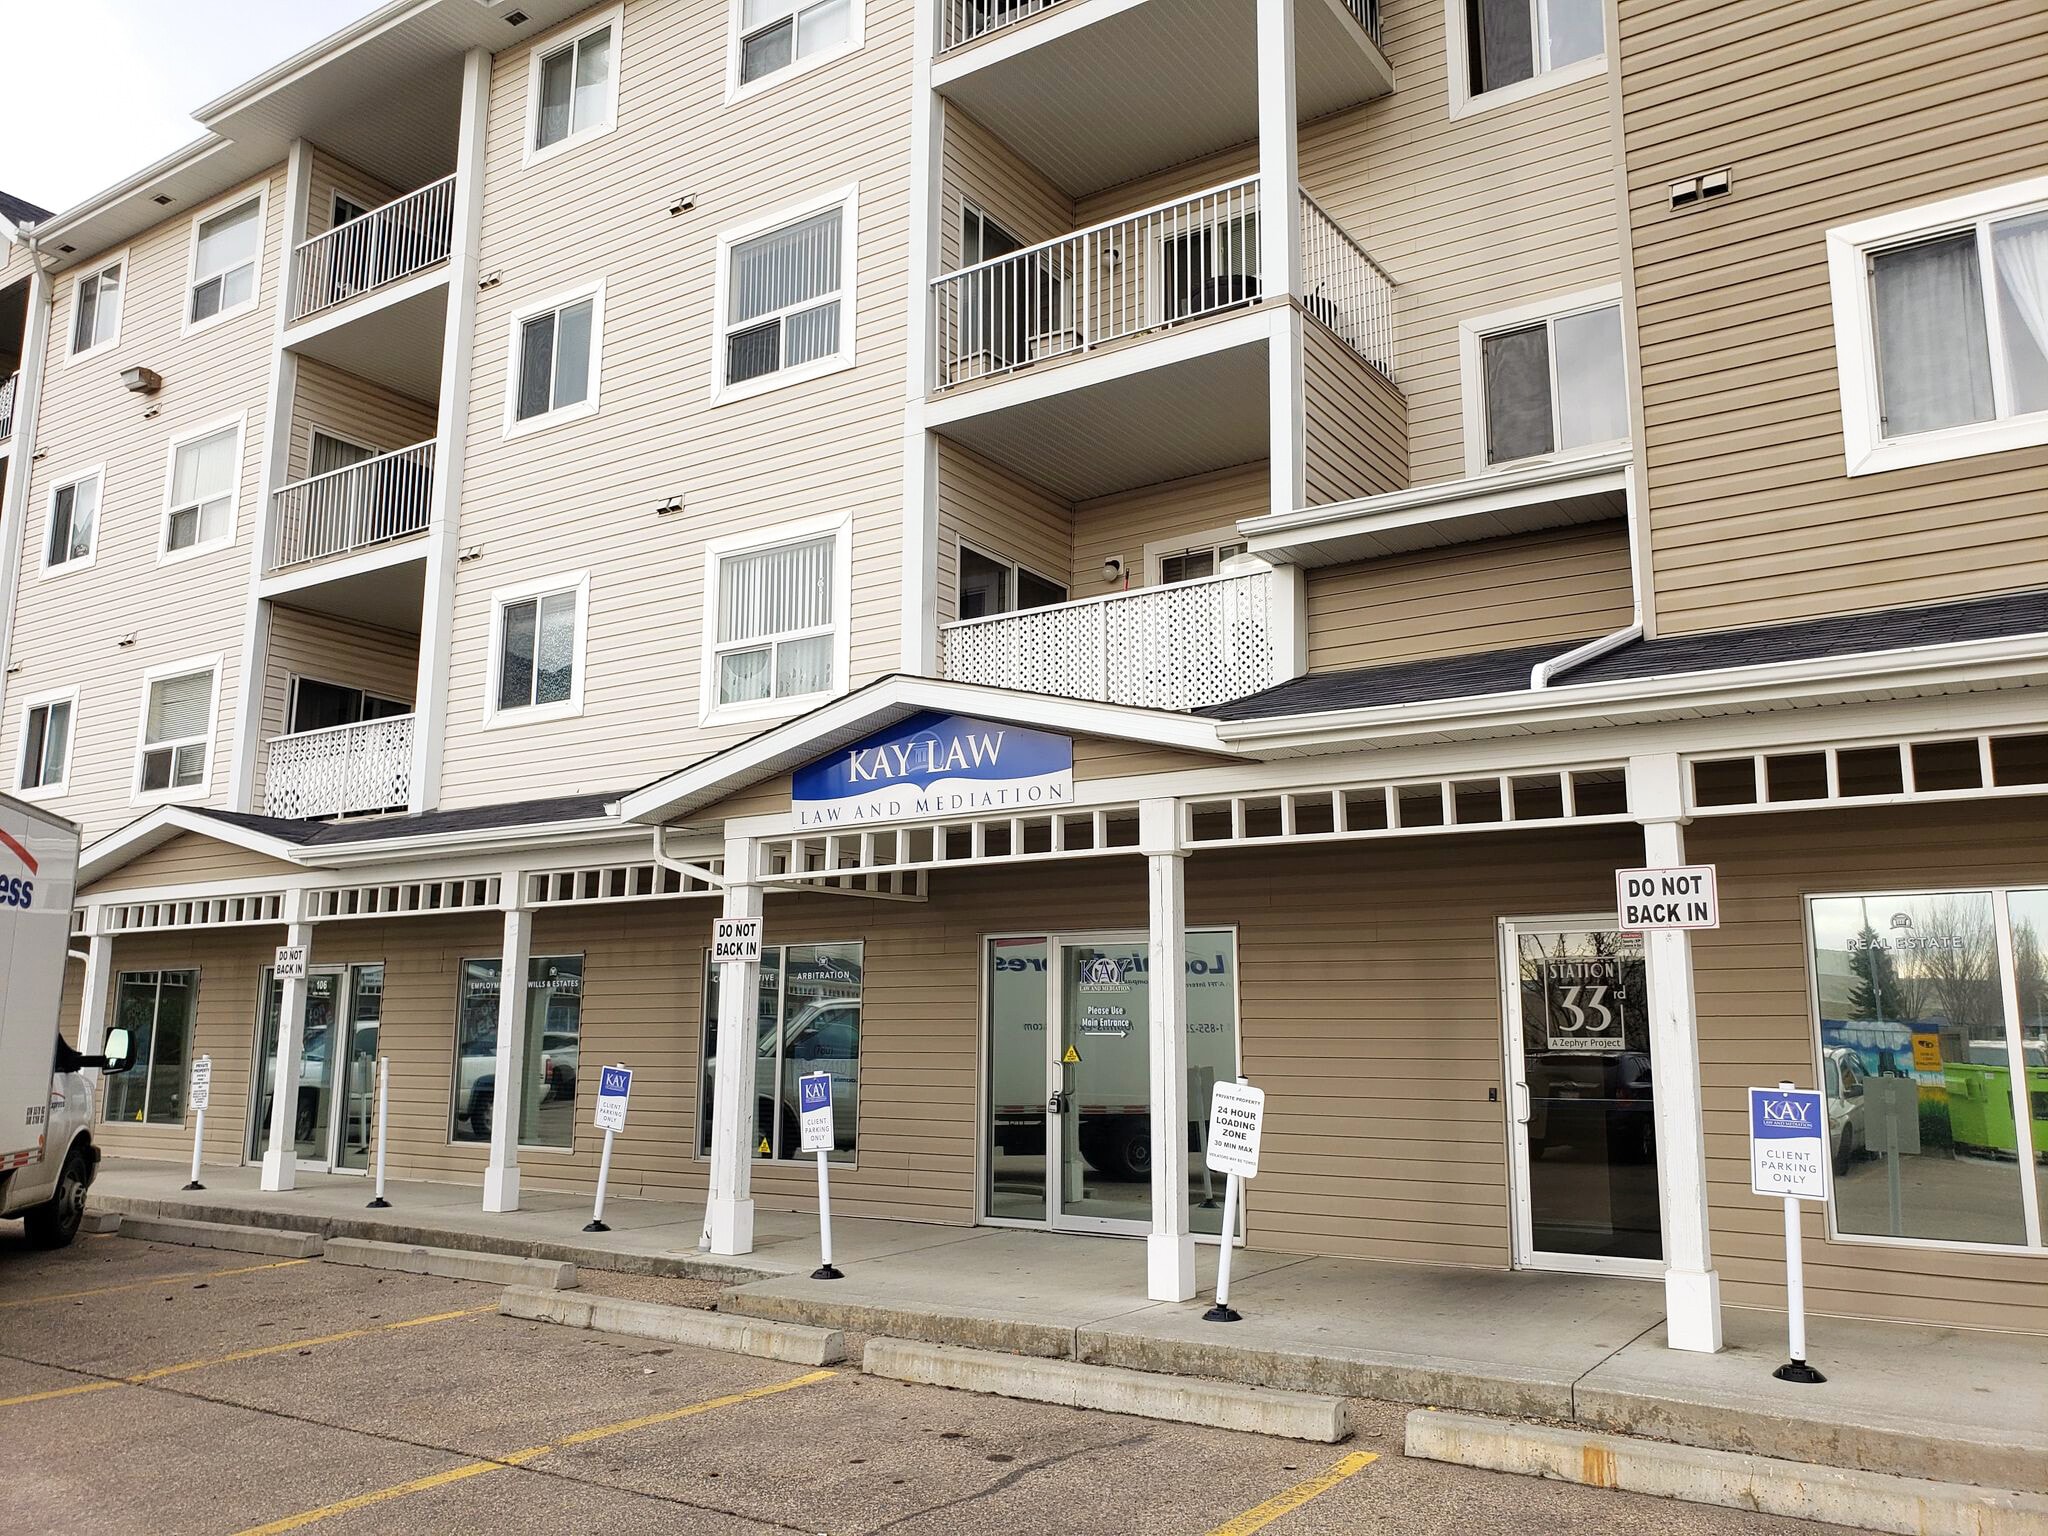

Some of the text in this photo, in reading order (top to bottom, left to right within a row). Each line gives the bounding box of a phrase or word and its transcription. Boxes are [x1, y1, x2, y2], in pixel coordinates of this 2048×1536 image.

[849, 731, 1006, 783] KAY LAW
[801, 783, 1064, 825] LAW AND MEDIATION
[1628, 875, 1702, 898] DO NOT
[1626, 902, 1708, 924] BACK IN
[719, 923, 756, 938] DO NOT
[716, 941, 757, 956] BACK IN
[1846, 935, 1963, 950] REAL ESTATE
[279, 950, 302, 961] DO NOT
[276, 964, 302, 975] BACK IN
[796, 971, 850, 980] ARBITRATION
[1080, 959, 1131, 985] KAY
[1549, 962, 1614, 979] STATION
[471, 982, 502, 990] EMPLOYM
[528, 980, 579, 988] WILLS & ESTATES
[1087, 1005, 1123, 1015] Please Use
[1082, 1017, 1130, 1027] Main Entrance
[1559, 1039, 1588, 1048] Zephyr
[1590, 1039, 1621, 1048] Project
[606, 1073, 627, 1088] KAY
[805, 1082, 827, 1099] KAY
[602, 1101, 622, 1110] CLIENT
[1215, 1093, 1261, 1106] PRIVATE PROPERTY
[599, 1108, 623, 1118] PARKING
[1217, 1105, 1257, 1121] 24 HOUR
[1762, 1099, 1812, 1121] KAY
[603, 1115, 618, 1123] ONLY
[807, 1117, 827, 1126] CLIENT
[1216, 1116, 1256, 1131] LOADING
[804, 1125, 830, 1133] PARKING
[1222, 1128, 1248, 1141] ZONE
[810, 1134, 826, 1142] ONLY
[1213, 1139, 1254, 1154] 30 MIN MAX
[1766, 1149, 1811, 1161] CLIENT
[1761, 1160, 1817, 1174] PARKING
[1772, 1173, 1806, 1185] ONLY
